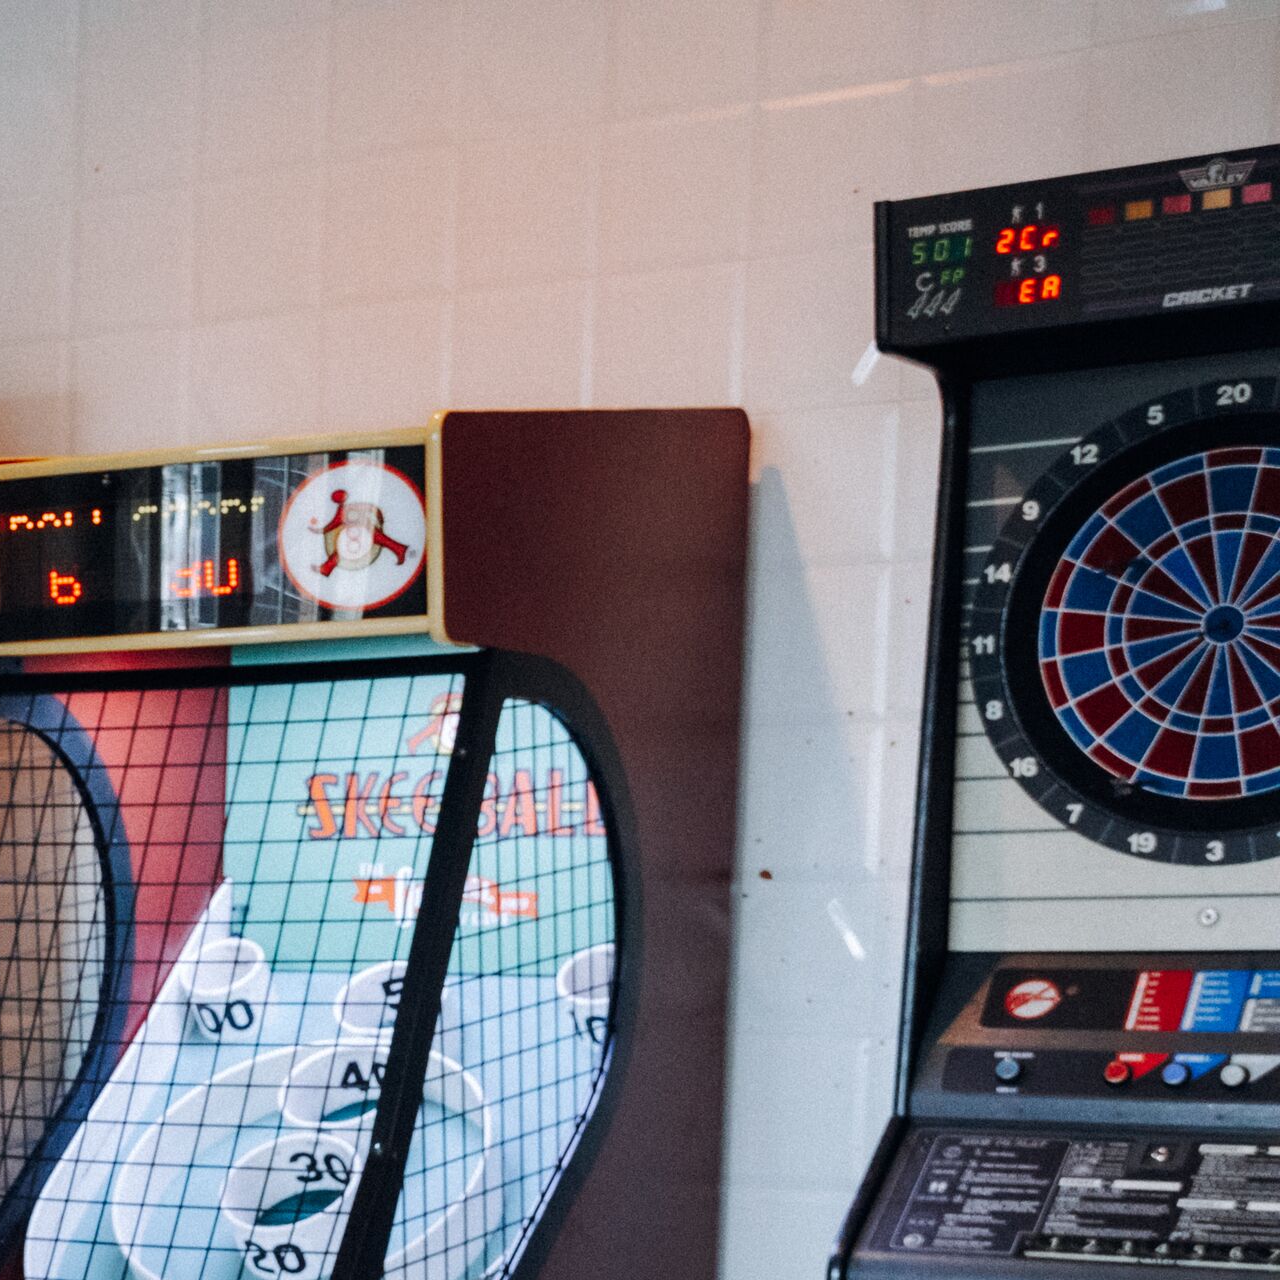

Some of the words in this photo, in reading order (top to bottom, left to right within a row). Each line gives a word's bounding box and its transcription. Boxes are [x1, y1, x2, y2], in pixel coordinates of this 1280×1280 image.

[1162, 283, 1254, 308] CRICKET
[1216, 383, 1252, 405] 20
[1147, 404, 1165, 425] 5
[1070, 444, 1099, 465] 12
[1022, 501, 1040, 521] 9
[984, 562, 1012, 584] 14
[972, 634, 995, 654] 11
[985, 700, 1003, 720] 8
[1009, 757, 1039, 778] 16
[1066, 803, 1084, 824] 7
[1127, 832, 1158, 853] 19
[1205, 840, 1225, 862] 3
[289, 1151, 351, 1184] 30
[244, 1239, 307, 1274] 20
